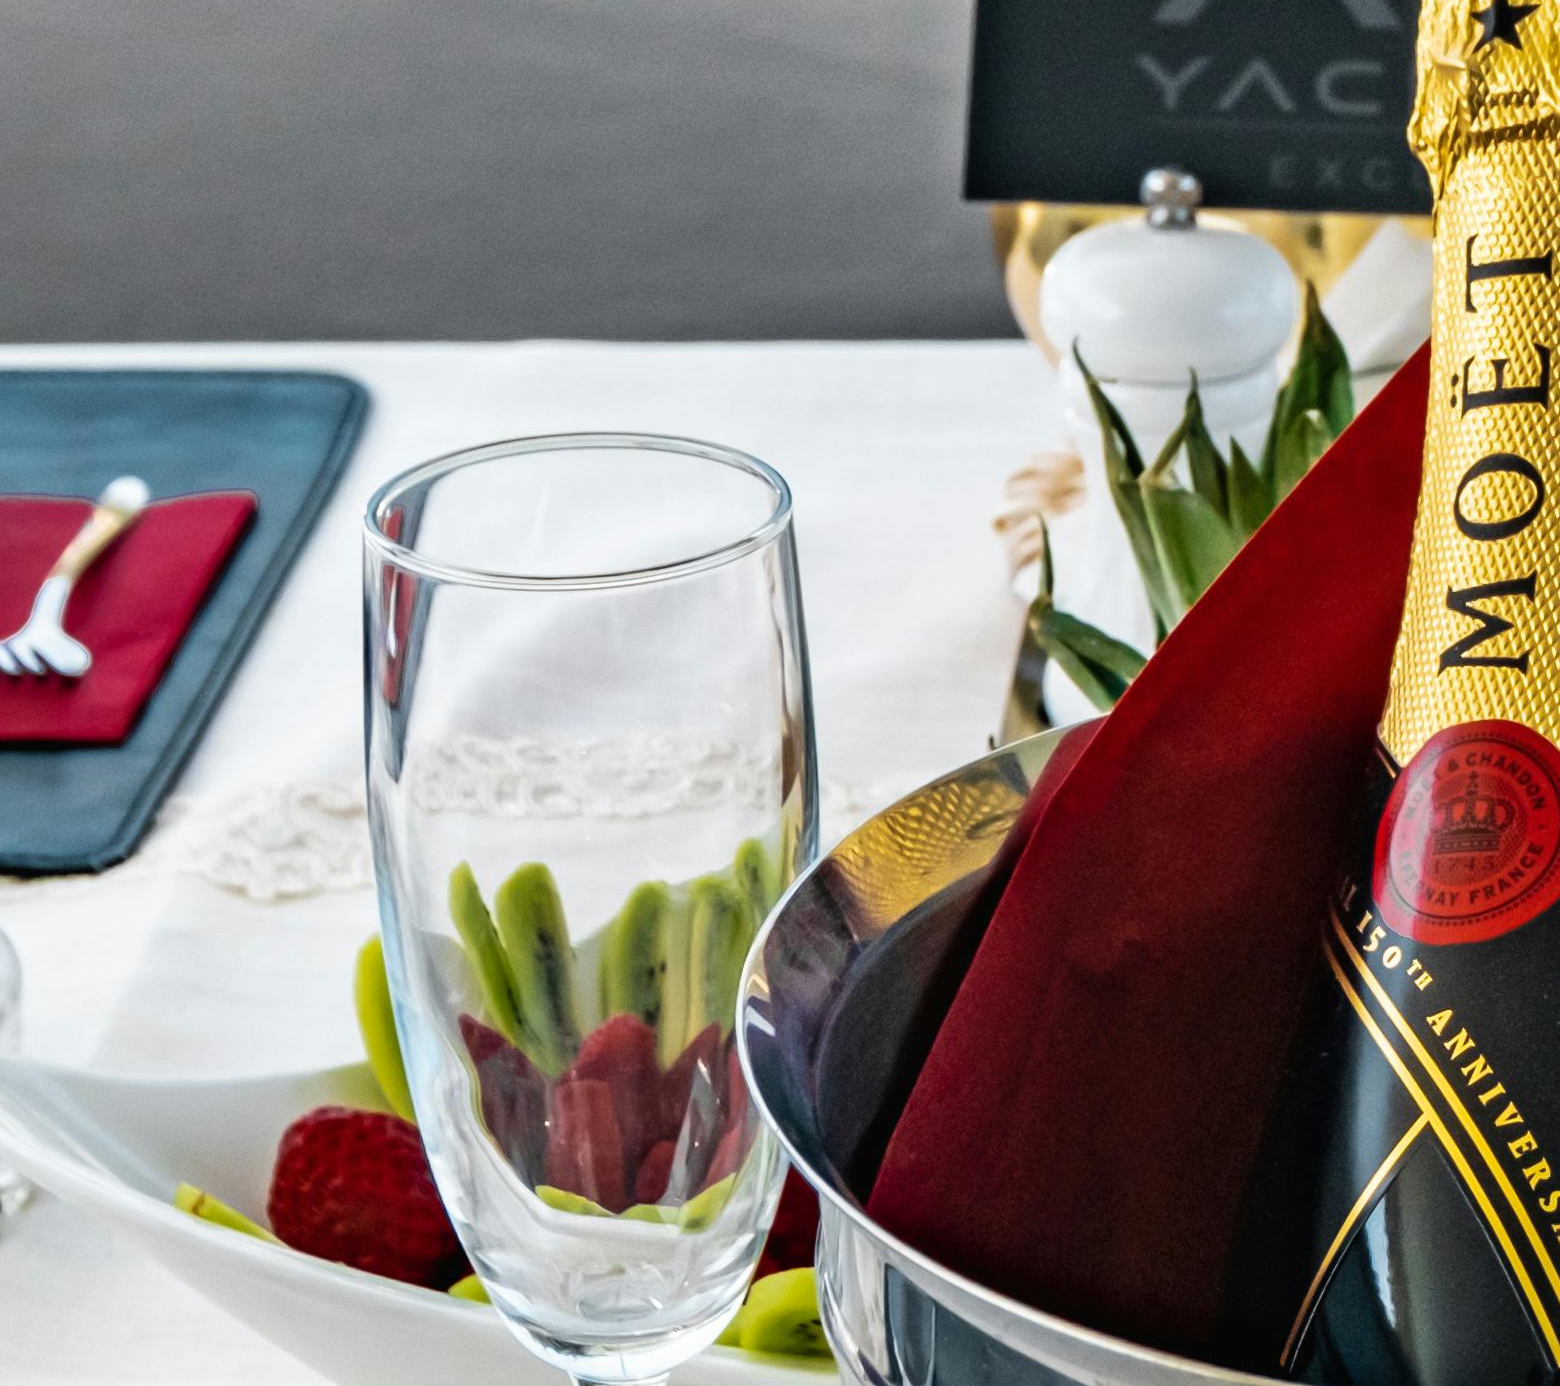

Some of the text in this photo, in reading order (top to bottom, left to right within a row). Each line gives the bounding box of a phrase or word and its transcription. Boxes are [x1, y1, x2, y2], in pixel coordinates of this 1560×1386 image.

[1438, 235, 1554, 676] MOËT
[1464, 751, 1547, 811] CHANDON
[1467, 841, 1546, 905] FRANCE
